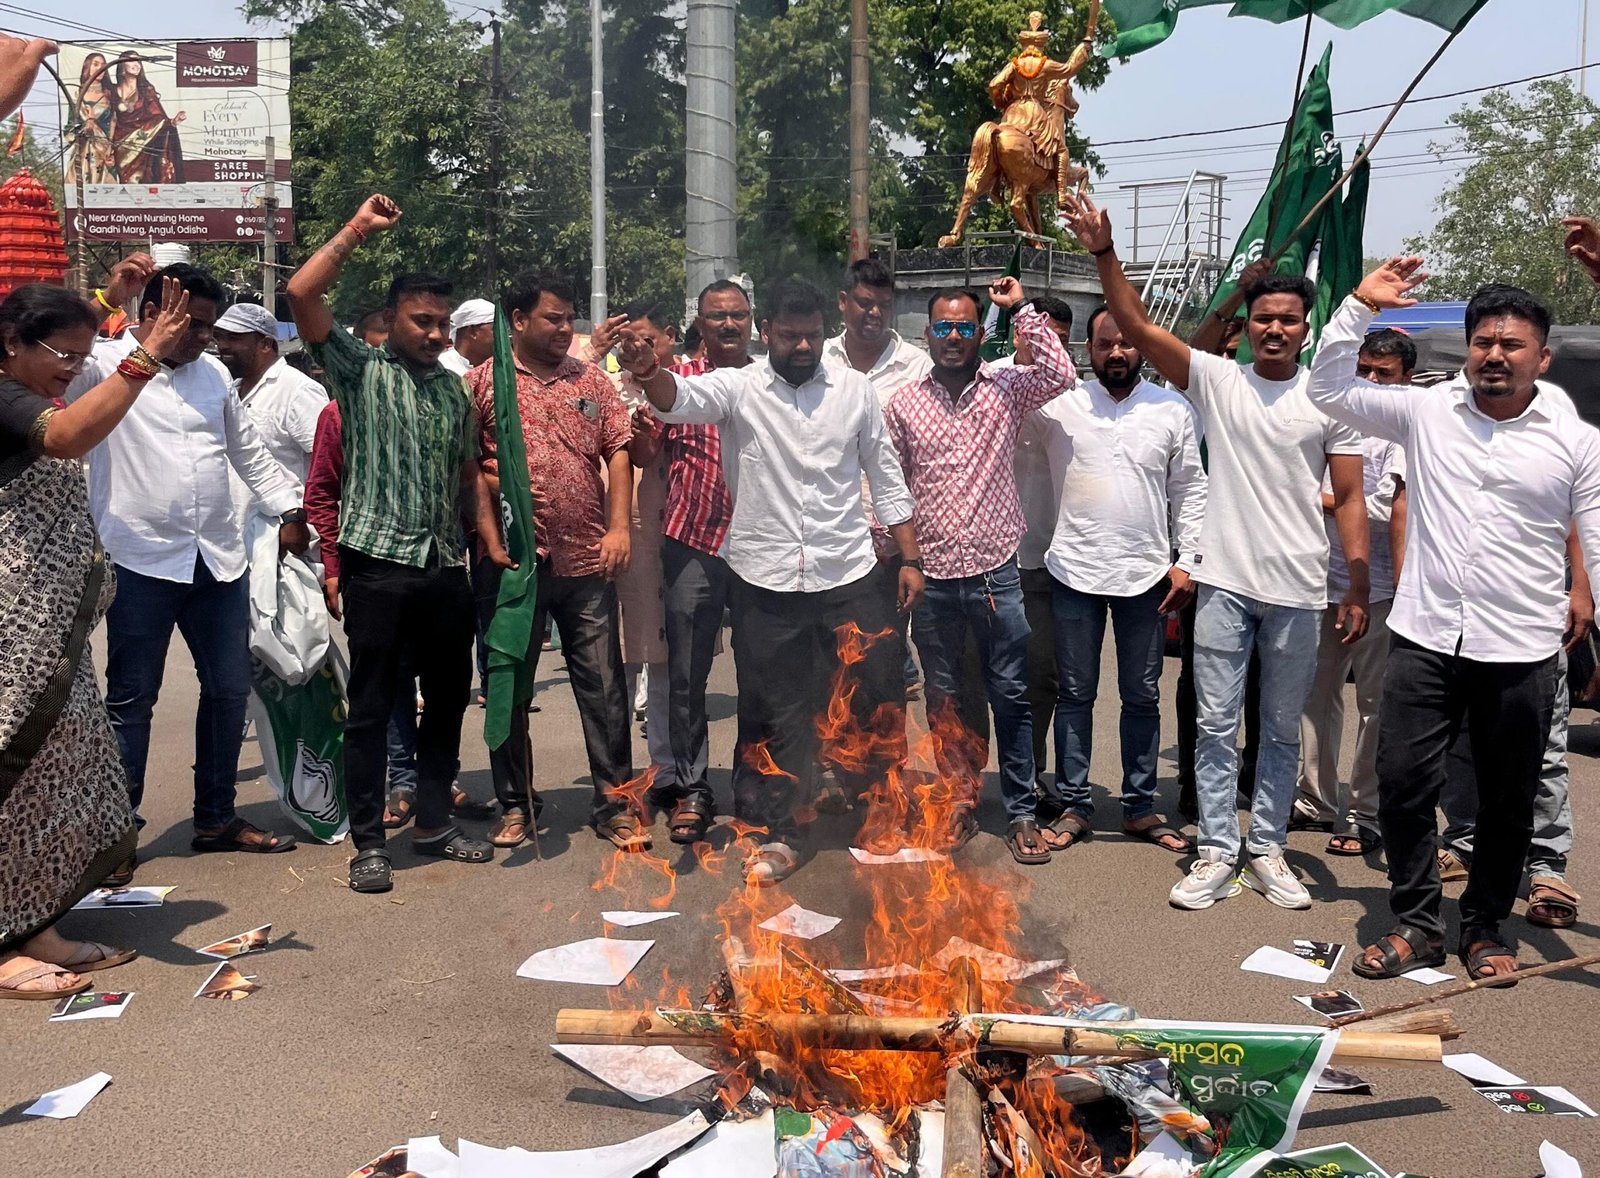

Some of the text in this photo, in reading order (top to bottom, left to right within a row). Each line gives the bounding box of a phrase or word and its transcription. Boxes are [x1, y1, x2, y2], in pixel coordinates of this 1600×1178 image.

[183, 65, 250, 77] MOHOTSAV
[203, 110, 242, 125] Every
[203, 125, 258, 137] Moment
[226, 139, 259, 147] Shopping
[204, 148, 247, 156] Mohotsav
[214, 162, 248, 170] SAREE
[214, 171, 265, 180] SHOPPIN
[88, 213, 205, 225] Near Kalyani Nursing Home
[89, 224, 208, 237] Gandhi Marg, Angul, Odisha
